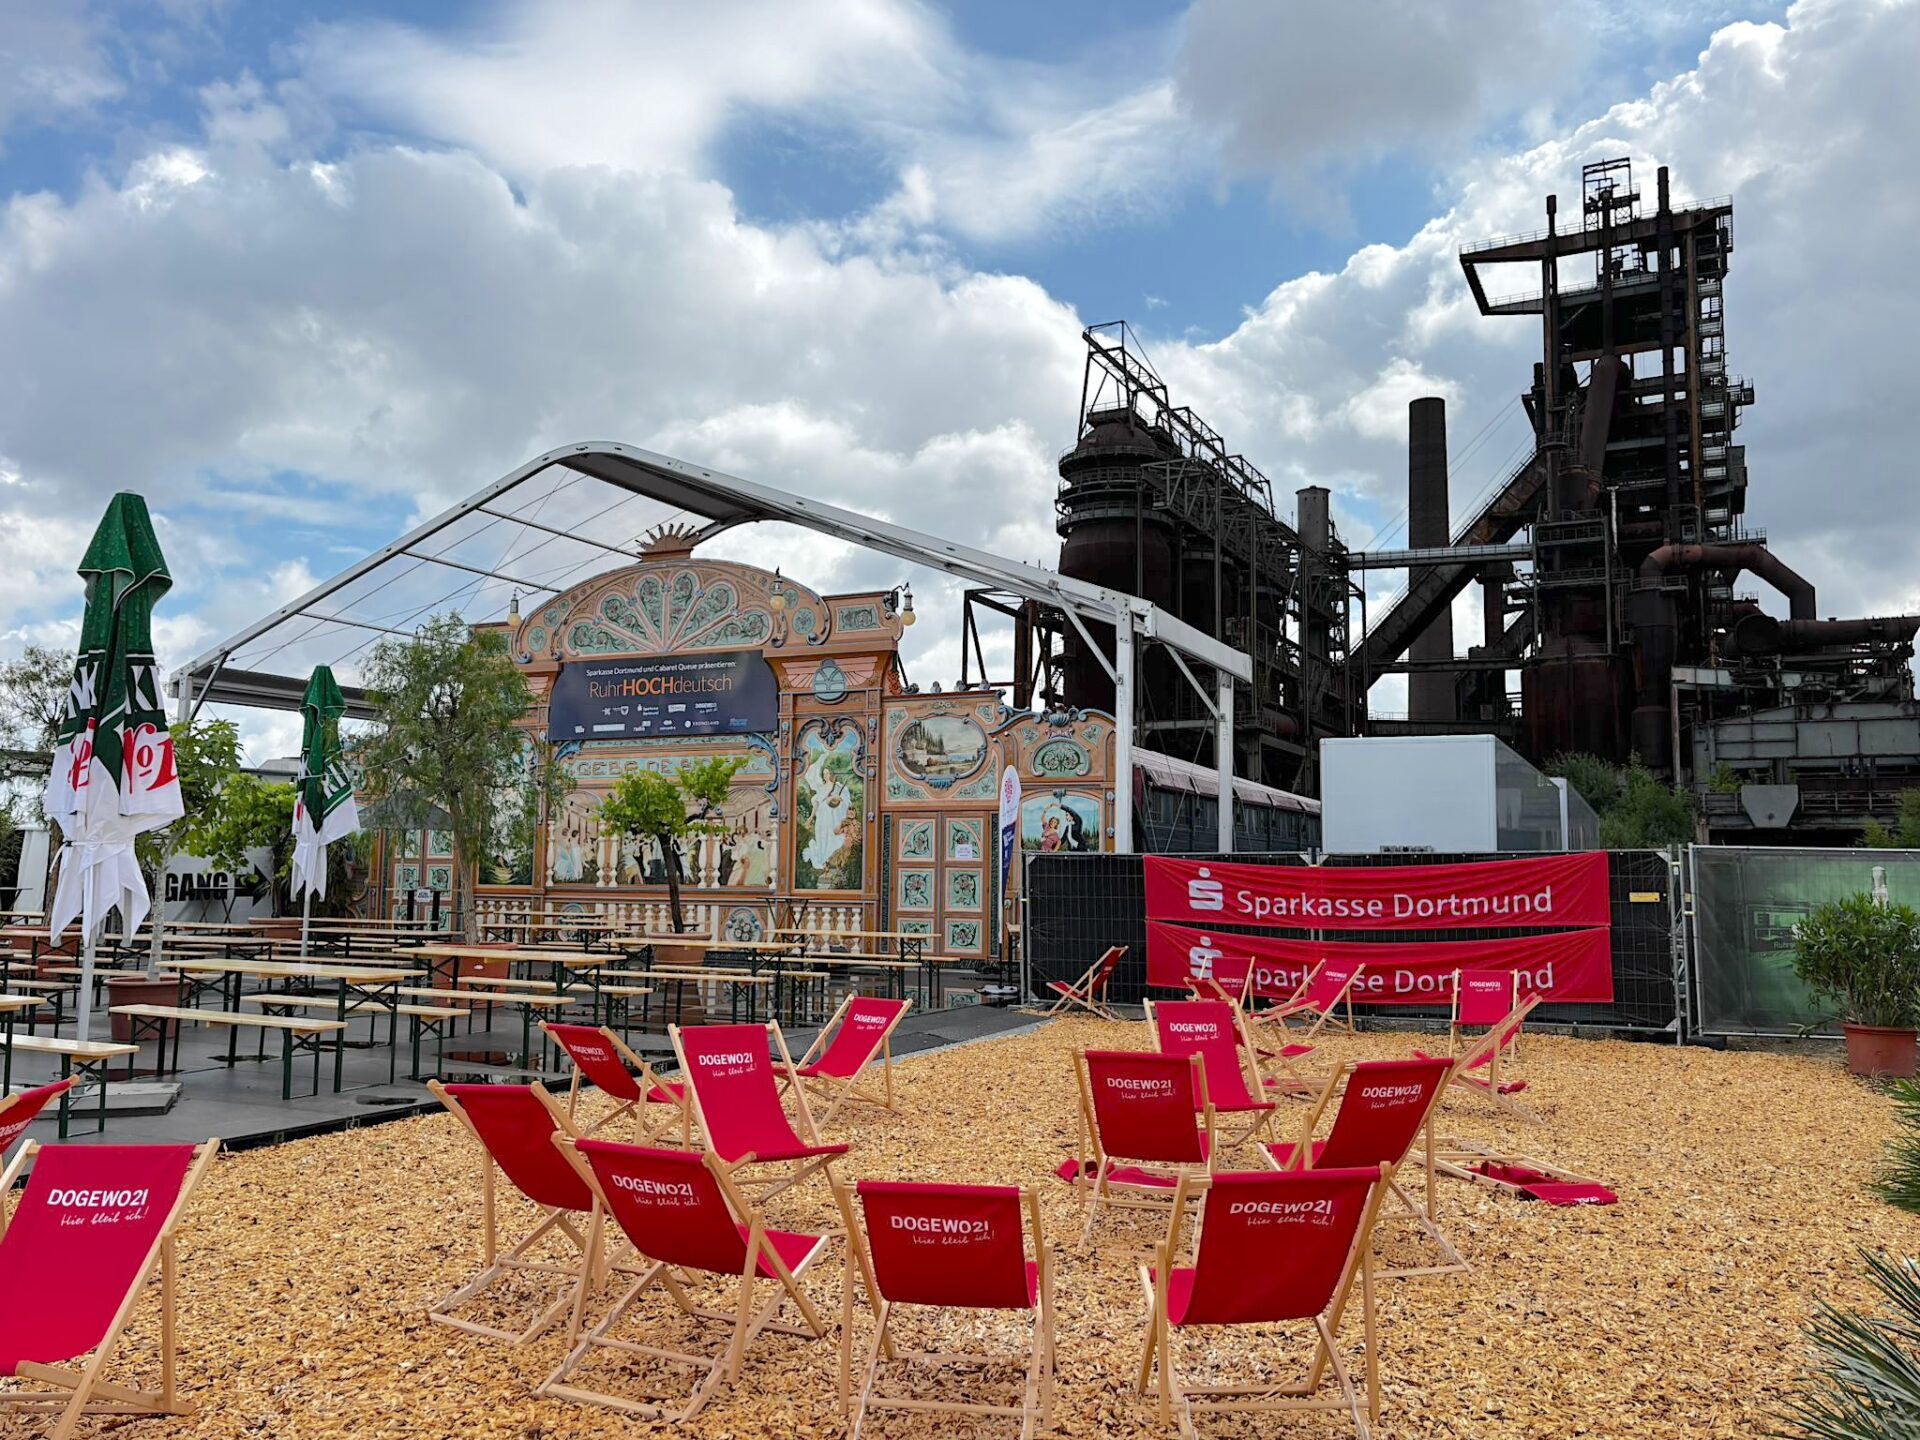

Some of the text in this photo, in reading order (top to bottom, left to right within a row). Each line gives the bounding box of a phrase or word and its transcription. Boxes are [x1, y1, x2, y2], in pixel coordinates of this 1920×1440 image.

[586, 668, 614, 677] Sparkasse
[614, 666, 643, 675] Dortmund
[643, 665, 654, 673] und
[654, 664, 678, 672] Cabaret
[678, 663, 698, 672] Queue
[590, 673, 732, 698] RuhrHOCHdeutsch
[1236, 885, 1553, 918] Sparkasse Dortmund
[1394, 961, 1553, 993] Dortnd
[60, 1213, 86, 1227] Hier
[90, 1211, 119, 1225] bleib
[1247, 1216, 1271, 1226] Hier
[1277, 1215, 1306, 1224] bleib
[913, 1234, 936, 1245] Hier
[942, 1233, 969, 1245] bleib
